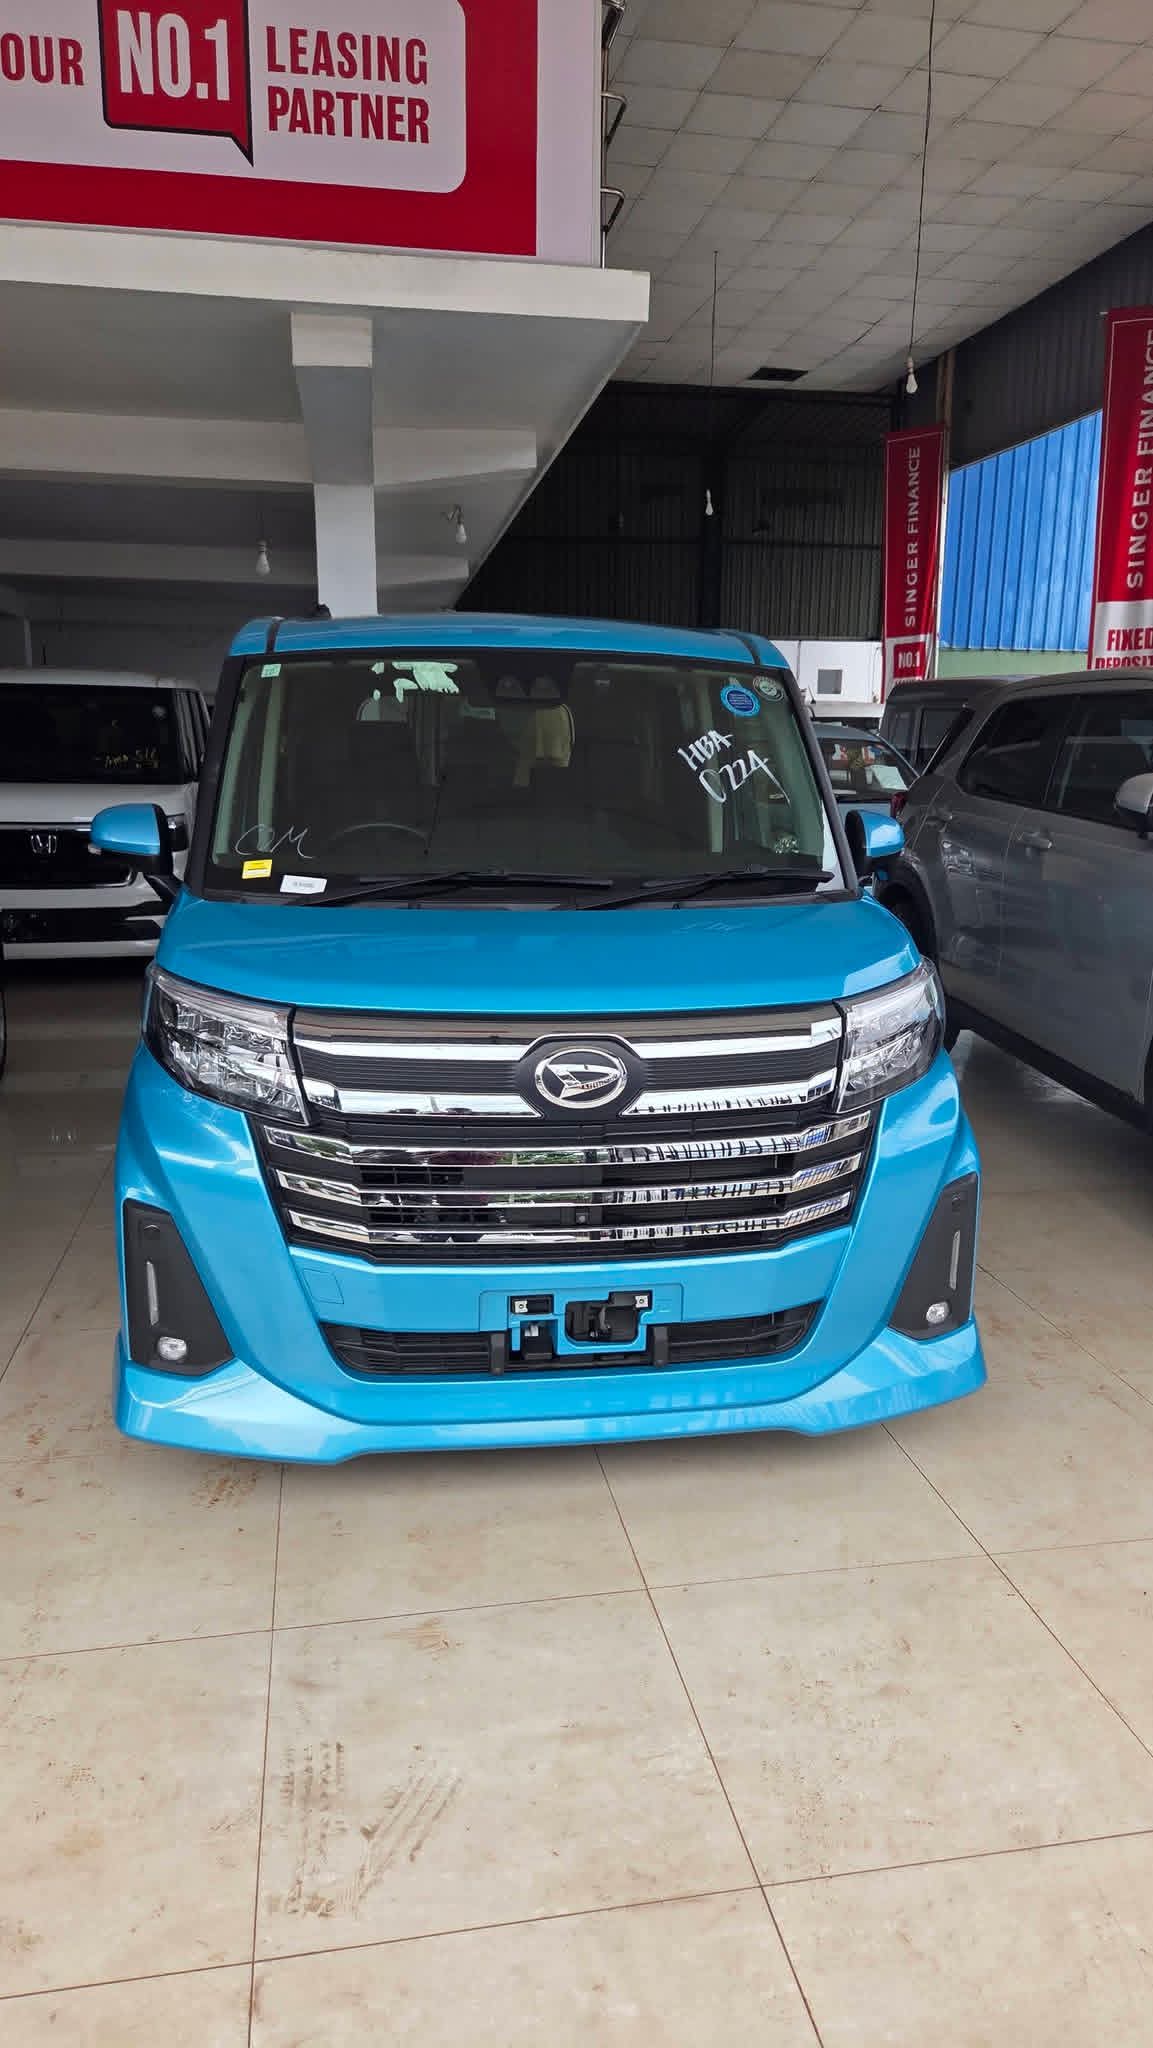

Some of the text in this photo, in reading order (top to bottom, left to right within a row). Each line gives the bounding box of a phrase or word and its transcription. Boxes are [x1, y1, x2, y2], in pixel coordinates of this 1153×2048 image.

[0, 32, 84, 86] OUR
[116, 9, 231, 102] NO.1
[266, 26, 429, 85] LEASING
[266, 86, 431, 144] PARTNER
[1126, 328, 1153, 589] SINGER FINAN
[904, 447, 921, 627] SINGER FINANCE
[898, 650, 921, 669] NO.1
[1106, 628, 1153, 651] FIXED
[677, 730, 733, 771] HBA
